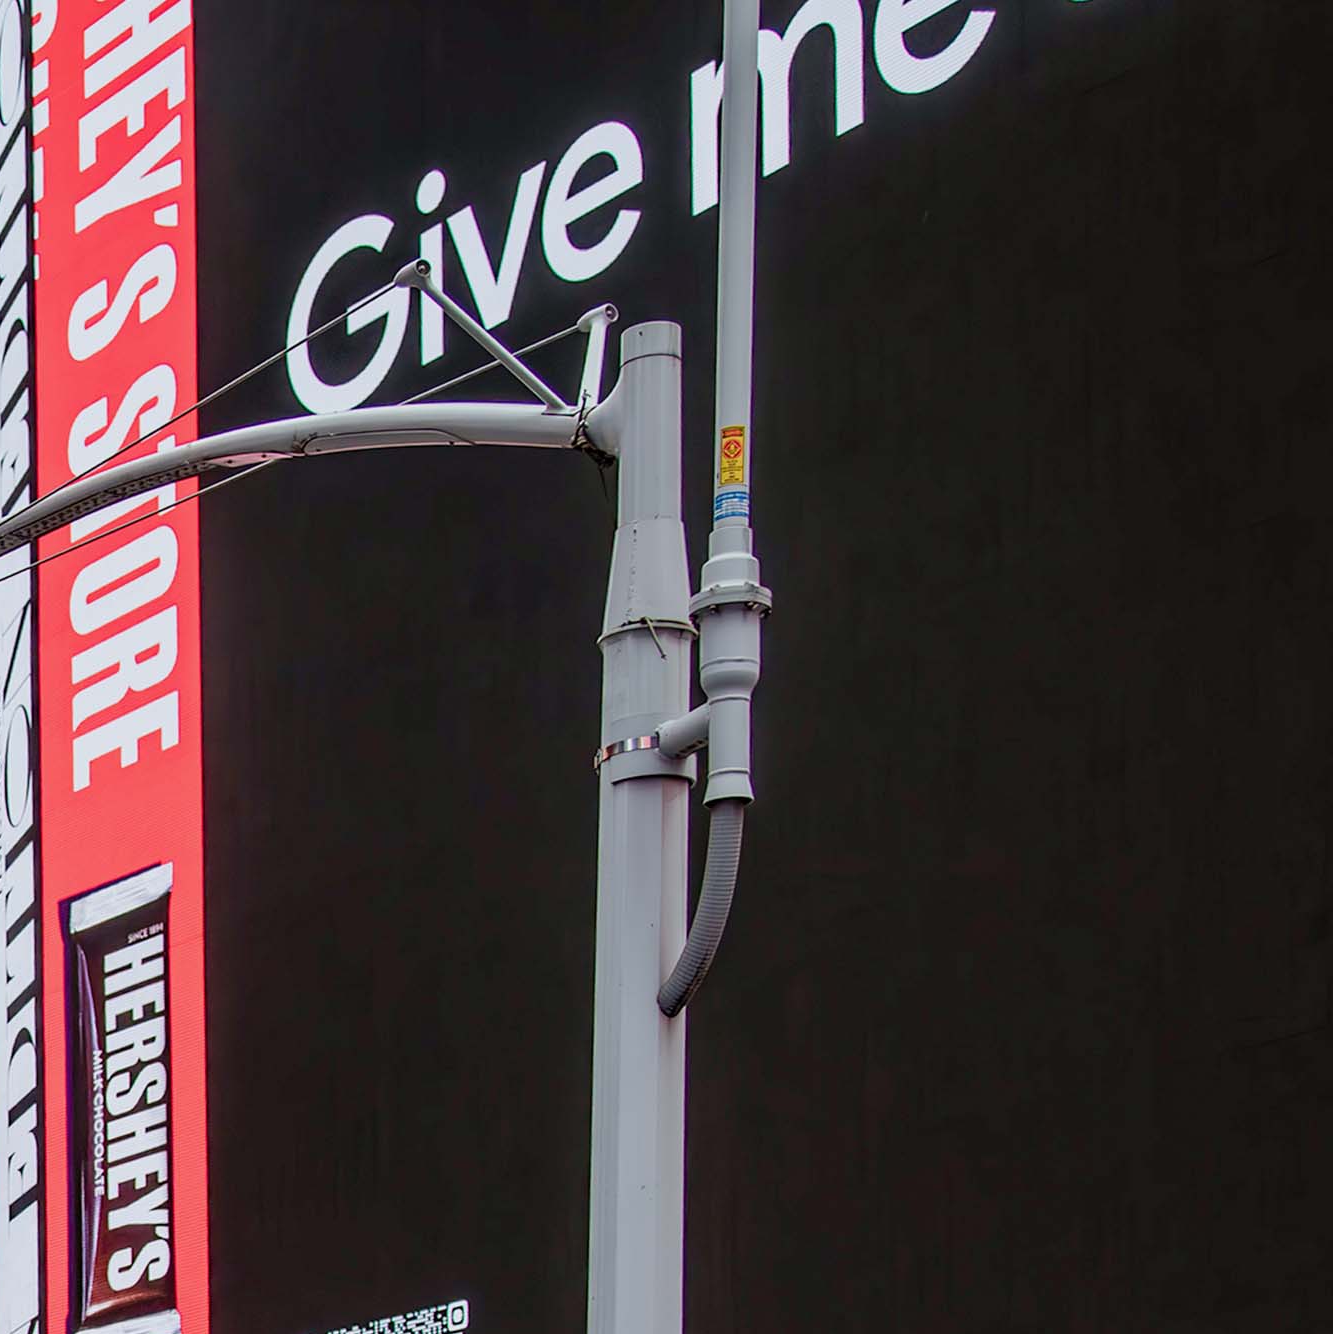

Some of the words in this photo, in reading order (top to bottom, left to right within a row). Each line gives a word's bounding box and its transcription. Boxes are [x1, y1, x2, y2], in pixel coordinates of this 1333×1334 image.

[285, 121, 644, 415] Give
[691, 0, 995, 216] me
[92, 1049, 103, 1094] MILK
[93, 1096, 104, 1199] CHOCOLATE
[103, 934, 171, 1292] HERSHEY'S
